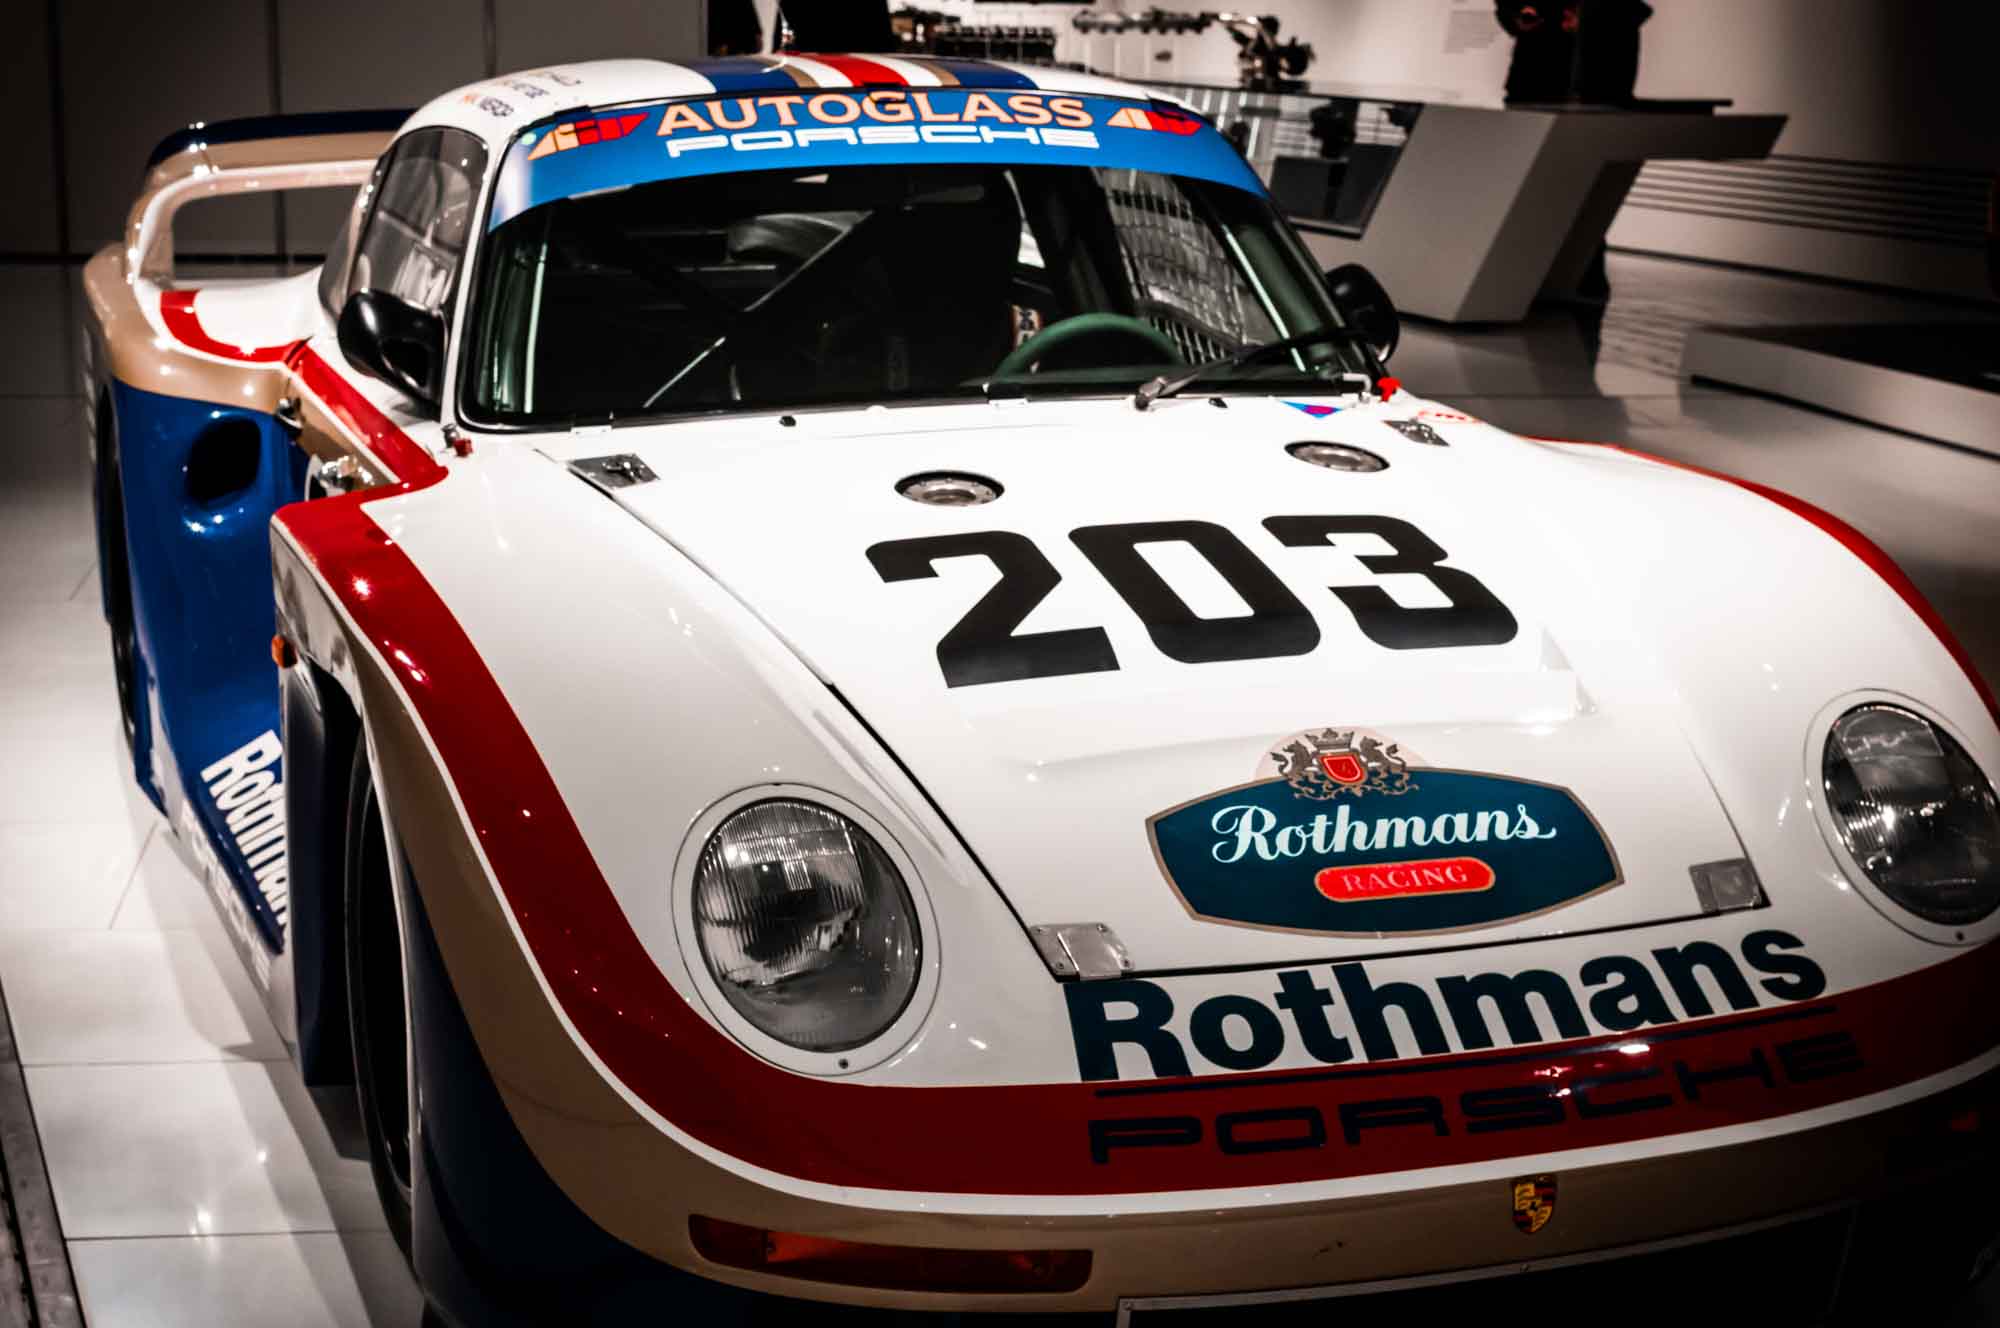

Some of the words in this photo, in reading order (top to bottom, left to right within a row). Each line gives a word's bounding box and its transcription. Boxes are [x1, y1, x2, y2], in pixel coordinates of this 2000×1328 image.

[656, 92, 1094, 136] AUTOGLASS
[666, 125, 1100, 158] PORSCHE
[865, 514, 1519, 688] 203
[201, 729, 287, 925] Rothma
[1211, 803, 1557, 864] Rothmans
[1341, 864, 1468, 893] RACING
[1063, 929, 1826, 1082] Rothmans
[1089, 1030, 1866, 1164] PORSCHE
